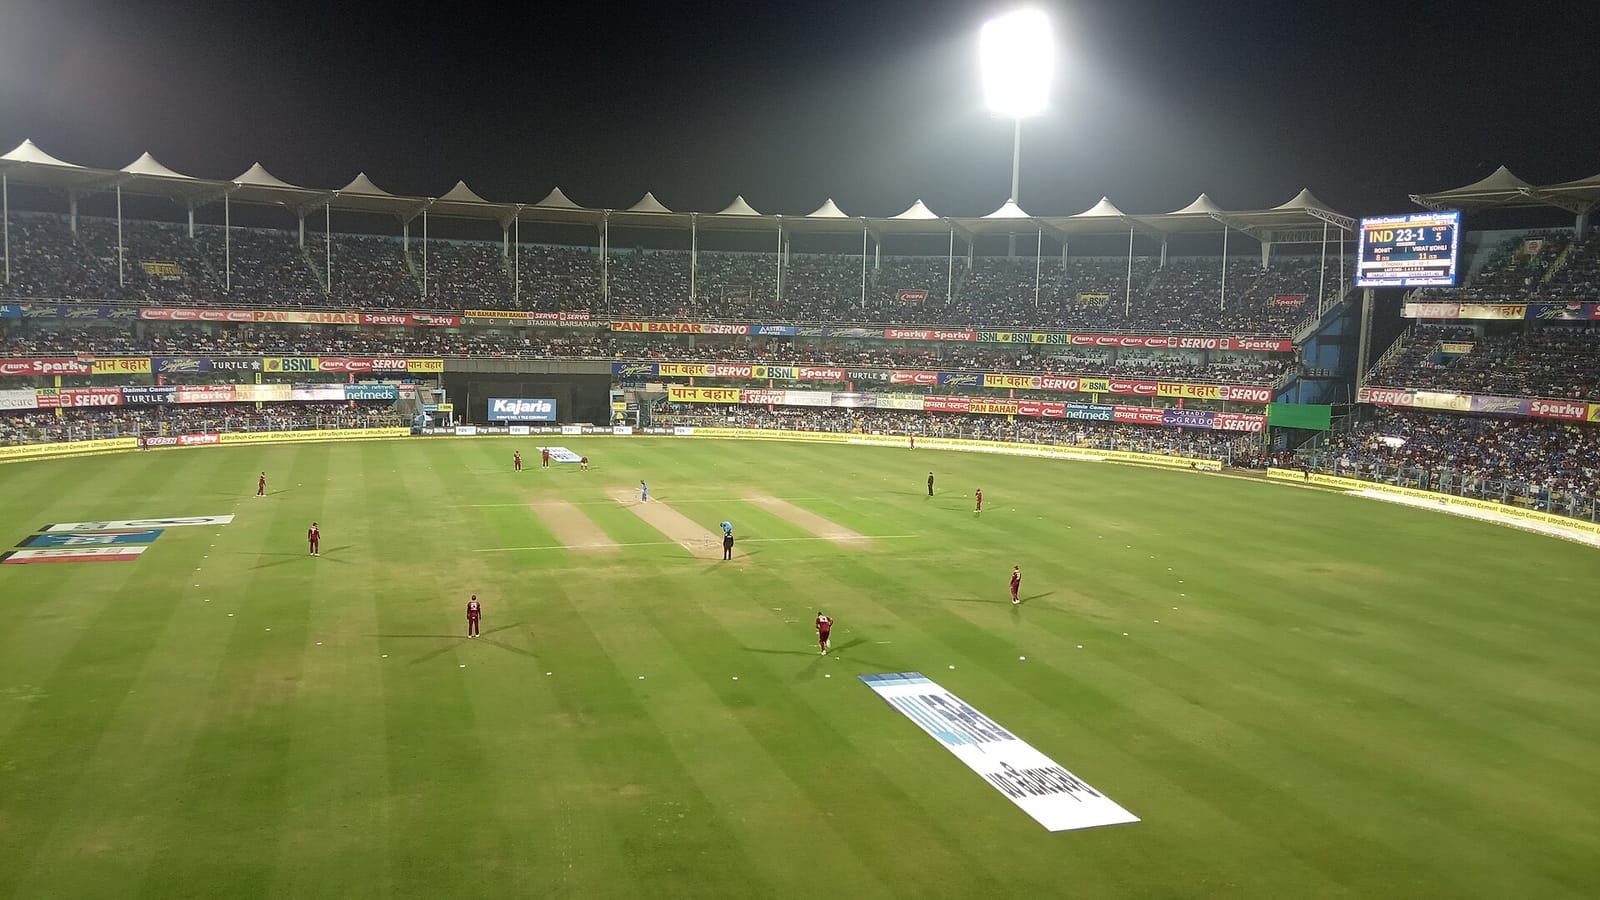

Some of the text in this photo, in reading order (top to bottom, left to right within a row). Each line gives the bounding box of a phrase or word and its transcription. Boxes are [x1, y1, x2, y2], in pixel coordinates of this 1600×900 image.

[1369, 230, 1394, 243] IND
[1395, 227, 1425, 242] 23-1
[1435, 232, 1442, 242] 5
[253, 311, 358, 324] PAN BAHAR
[365, 314, 406, 325] Sparky
[527, 319, 559, 328] STADIUM,
[612, 322, 702, 334] PAN BAHAR
[712, 325, 747, 335] SERVO
[890, 329, 928, 339] Sparky
[934, 330, 970, 340] Sparky
[977, 332, 1000, 342] BSNL
[1011, 333, 1034, 343] BSNL
[1046, 334, 1069, 344] BSNL
[1179, 338, 1217, 349] SERVO
[1238, 339, 1280, 350] Sparky
[211, 360, 248, 370] TURTLE
[281, 358, 317, 371] BSNL
[371, 359, 406, 369] SERVO
[716, 366, 751, 377] SERVO
[767, 366, 797, 379] BSNL
[799, 368, 842, 379] Sparky
[847, 371, 878, 380] TURTLE
[1041, 378, 1078, 390] SERVO
[1089, 381, 1108, 391] BSNL
[122, 386, 147, 394] Dalmia
[347, 389, 394, 400] netmeds
[671, 388, 698, 400] पान
[1230, 389, 1269, 402] SERVO
[75, 394, 118, 406] SERVO
[125, 394, 164, 404] TURTLE
[747, 394, 782, 404] SERVO
[1370, 391, 1412, 405] SERVO
[493, 399, 552, 416] Kajaria
[970, 404, 989, 414] PAN
[989, 404, 1017, 414] BAHAR
[1531, 401, 1585, 418] Sparky
[1066, 410, 1110, 421] netmeds
[1176, 416, 1213, 426] GRADO
[1222, 419, 1263, 433] SERVO
[181, 434, 217, 443] Sparky
[1500, 507, 1546, 522] UltraTech Cement
[1547, 517, 1574, 529] UltraTech
[1573, 522, 1595, 533] Cement
[985, 762, 1102, 802] Recharge on
